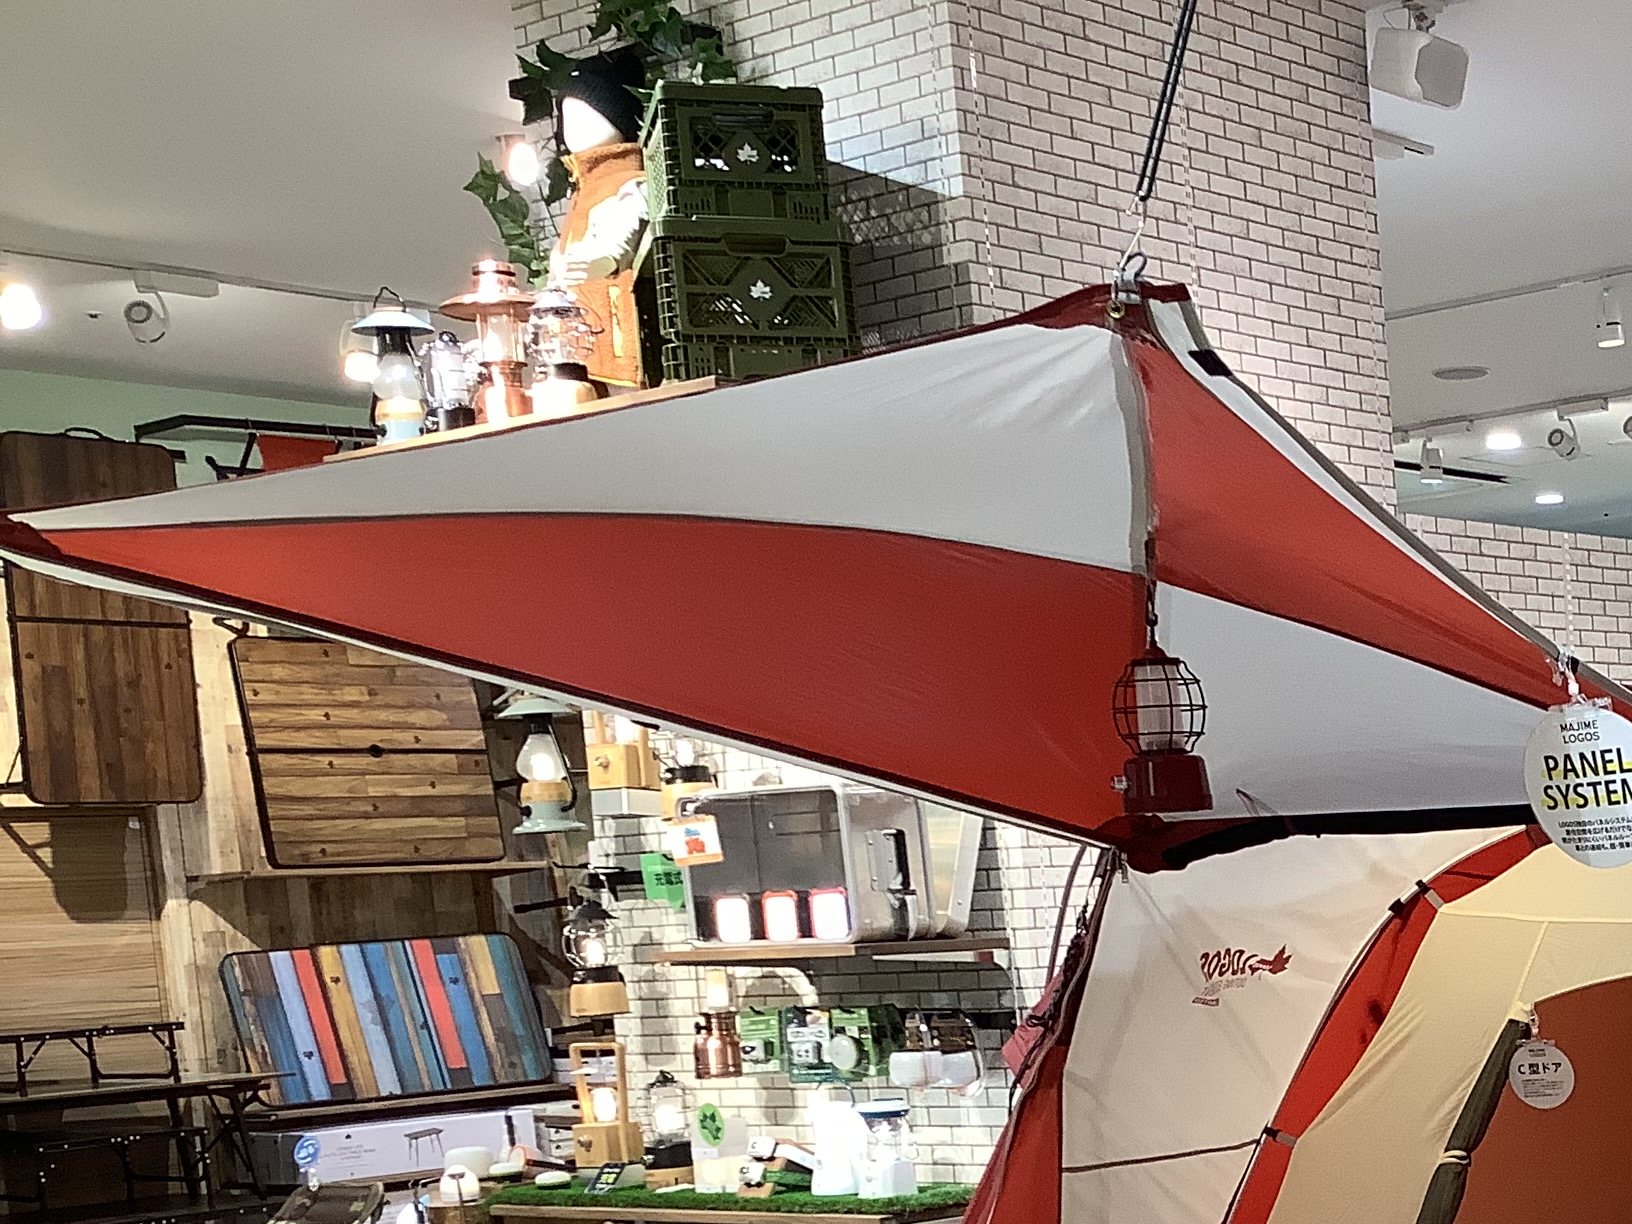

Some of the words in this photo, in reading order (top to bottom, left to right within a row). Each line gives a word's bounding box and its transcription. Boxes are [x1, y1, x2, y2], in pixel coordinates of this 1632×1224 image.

[1559, 719, 1600, 733] MAJIME
[1562, 731, 1601, 745] LOGOS
[1542, 747, 1632, 781] PANEL
